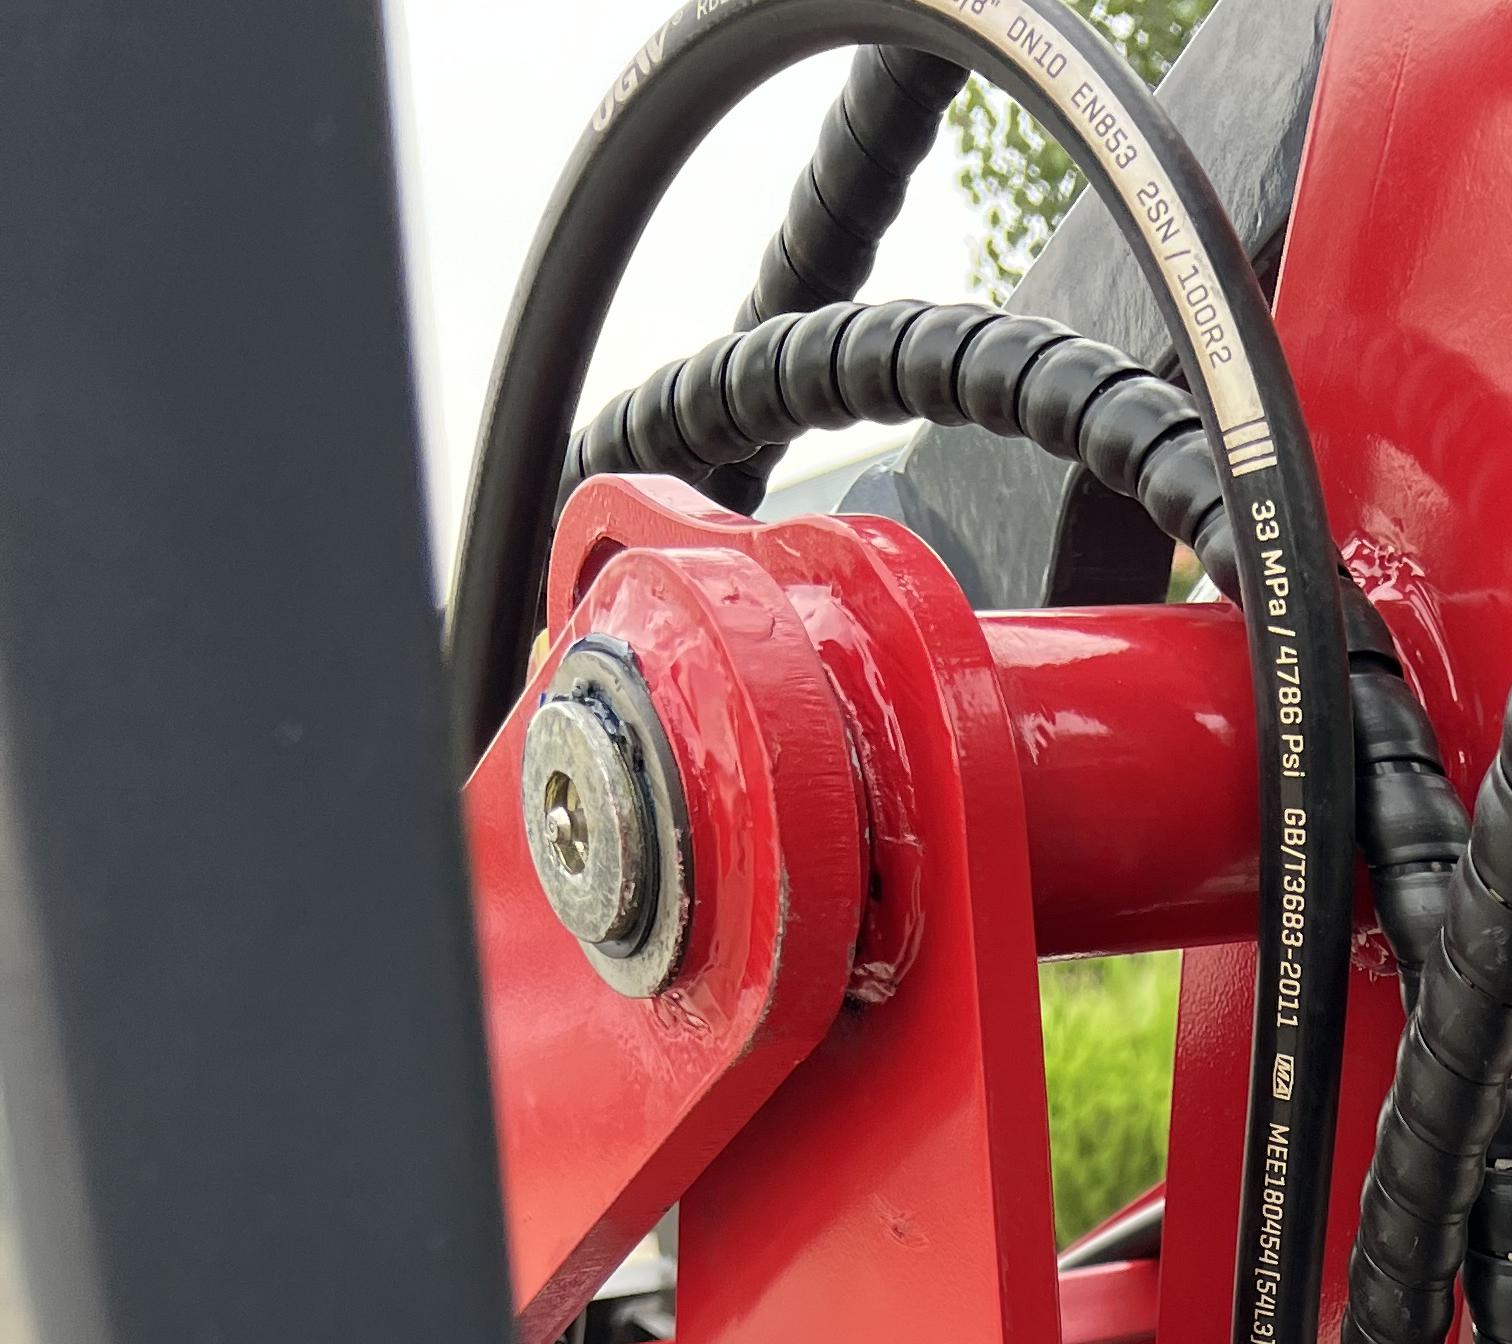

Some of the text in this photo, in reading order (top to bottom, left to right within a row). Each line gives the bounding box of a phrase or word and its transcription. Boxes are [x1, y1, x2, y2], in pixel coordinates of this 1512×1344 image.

[1006, 15, 1068, 79] DN10
[1070, 81, 1138, 169] EN853
[1251, 499, 1280, 543] 33
[1260, 549, 1290, 617] MPa
[1275, 645, 1303, 725] 4786
[1281, 734, 1306, 778] Psi
[1275, 807, 1307, 1028] GB/T3683-2011
